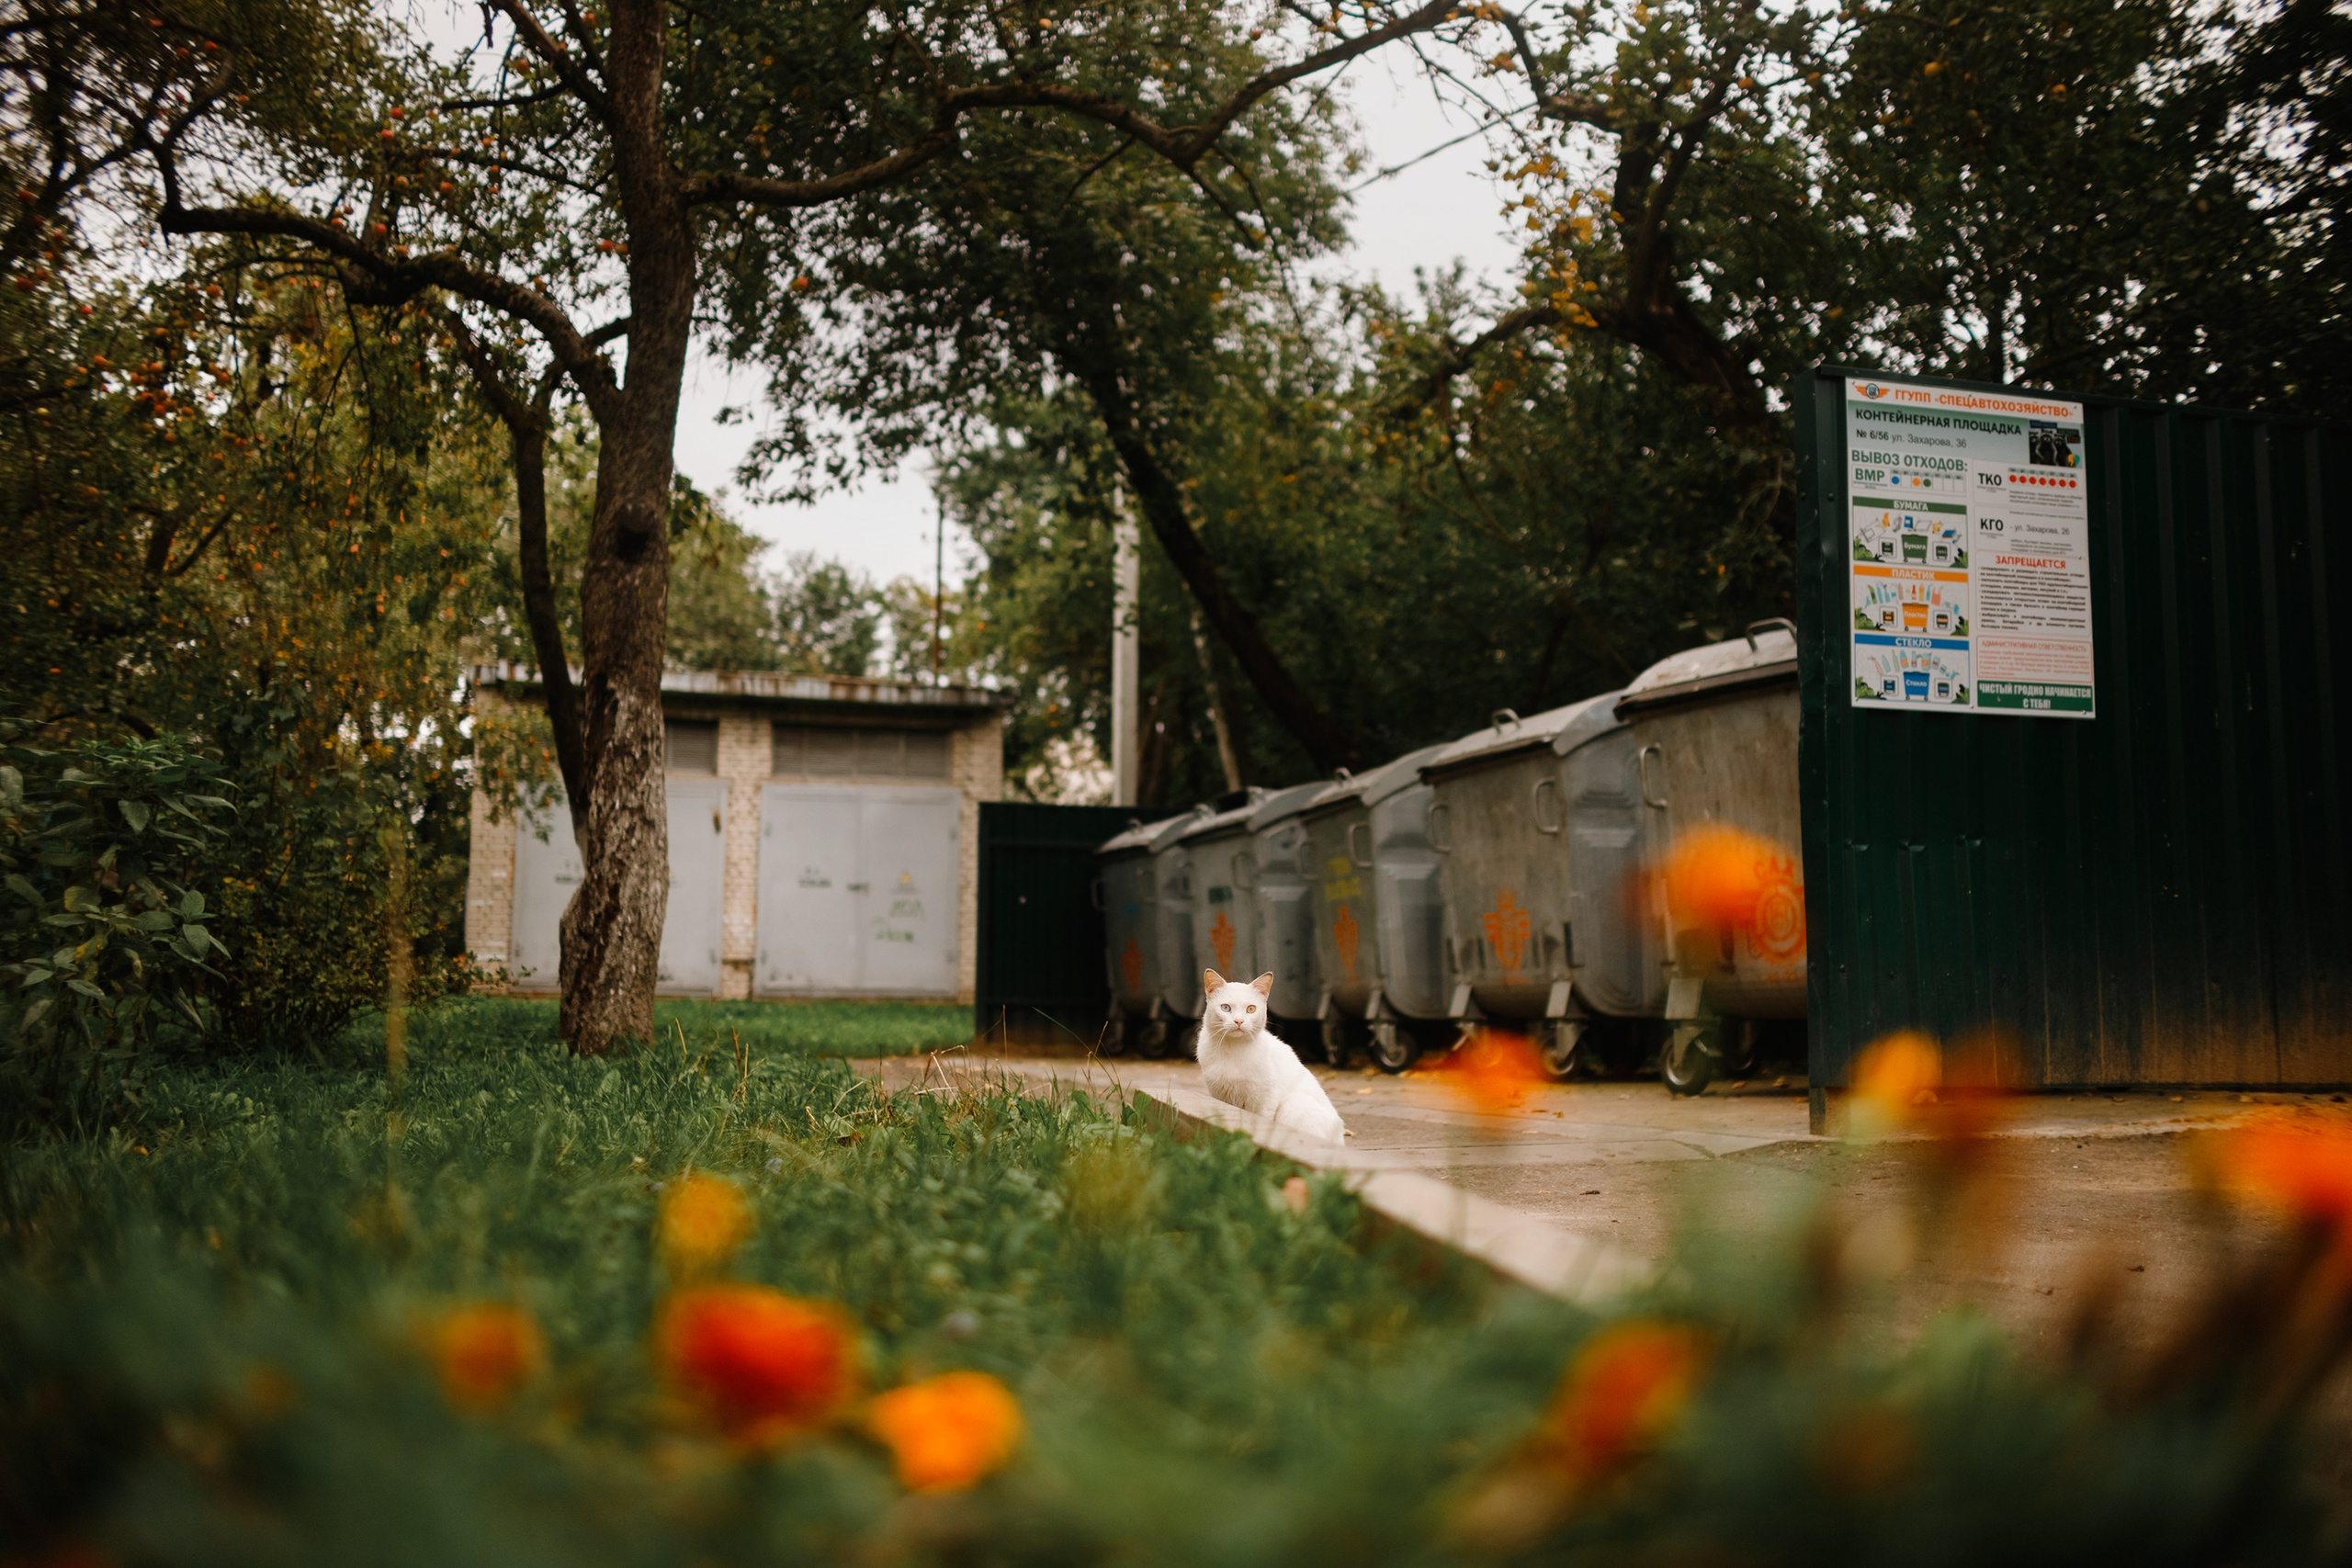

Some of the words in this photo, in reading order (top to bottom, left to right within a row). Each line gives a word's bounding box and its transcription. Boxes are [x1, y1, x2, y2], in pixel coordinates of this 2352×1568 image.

[1894, 389, 1931, 403] ГГУПП
[1856, 408, 1950, 428] КОНТЕЙНЕРНАЯ
[1953, 418, 2022, 435] ПЛОЩАДКА
[1856, 428, 1867, 438] №
[1870, 430, 1889, 441] 6/56
[1892, 433, 1905, 444] ул.
[1907, 434, 1953, 448] Захарова,
[1956, 438, 1967, 448] 36
[1851, 449, 1900, 466] ВЫВОЗ
[1904, 455, 1968, 472] ОТХОДОВ:
[1855, 468, 1885, 481] ВМР
[1978, 472, 2003, 486] ТКО
[1894, 500, 1928, 512] БУМАГА
[1980, 518, 2004, 531] КГО
[2014, 525, 2024, 533] ул.
[2026, 524, 2059, 536] Захарова,
[1904, 542, 1927, 550] Бумага
[1996, 555, 2066, 570] ЗАПРЕЩАЕТСЯ
[1892, 569, 1936, 580] ПЛАСТИК
[1904, 611, 1927, 619] Пластик
[1895, 637, 1932, 649] СТЕКЛО
[1905, 679, 1928, 687] Стекло
[1979, 682, 2013, 694] ЧИСТЫЙ
[2014, 684, 2044, 696] ГРОДНО
[2045, 687, 2092, 698] НАЧИНАЕТСЯ
[2023, 698, 2030, 708] С
[2030, 699, 2052, 709] ТЕБЯ!
